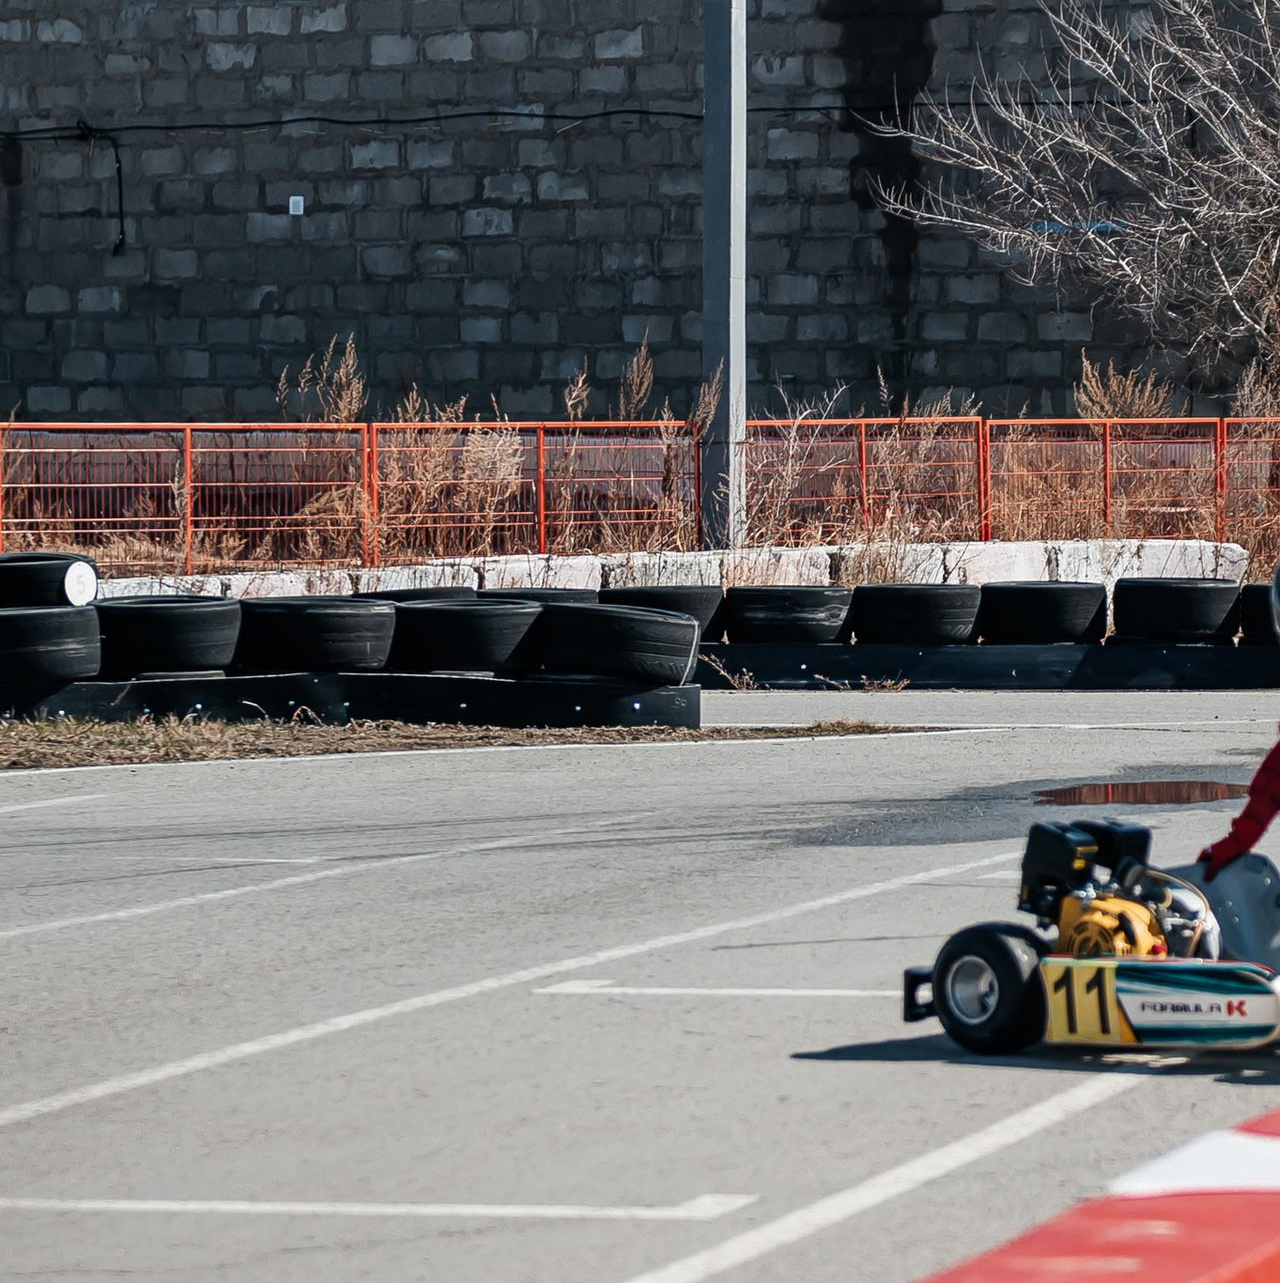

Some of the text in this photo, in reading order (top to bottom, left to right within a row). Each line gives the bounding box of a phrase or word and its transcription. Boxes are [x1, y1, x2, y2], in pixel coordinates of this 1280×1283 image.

[76, 574, 87, 595] 5
[1053, 965, 1112, 1036] 11
[1139, 999, 1248, 1018] FORMULA K
